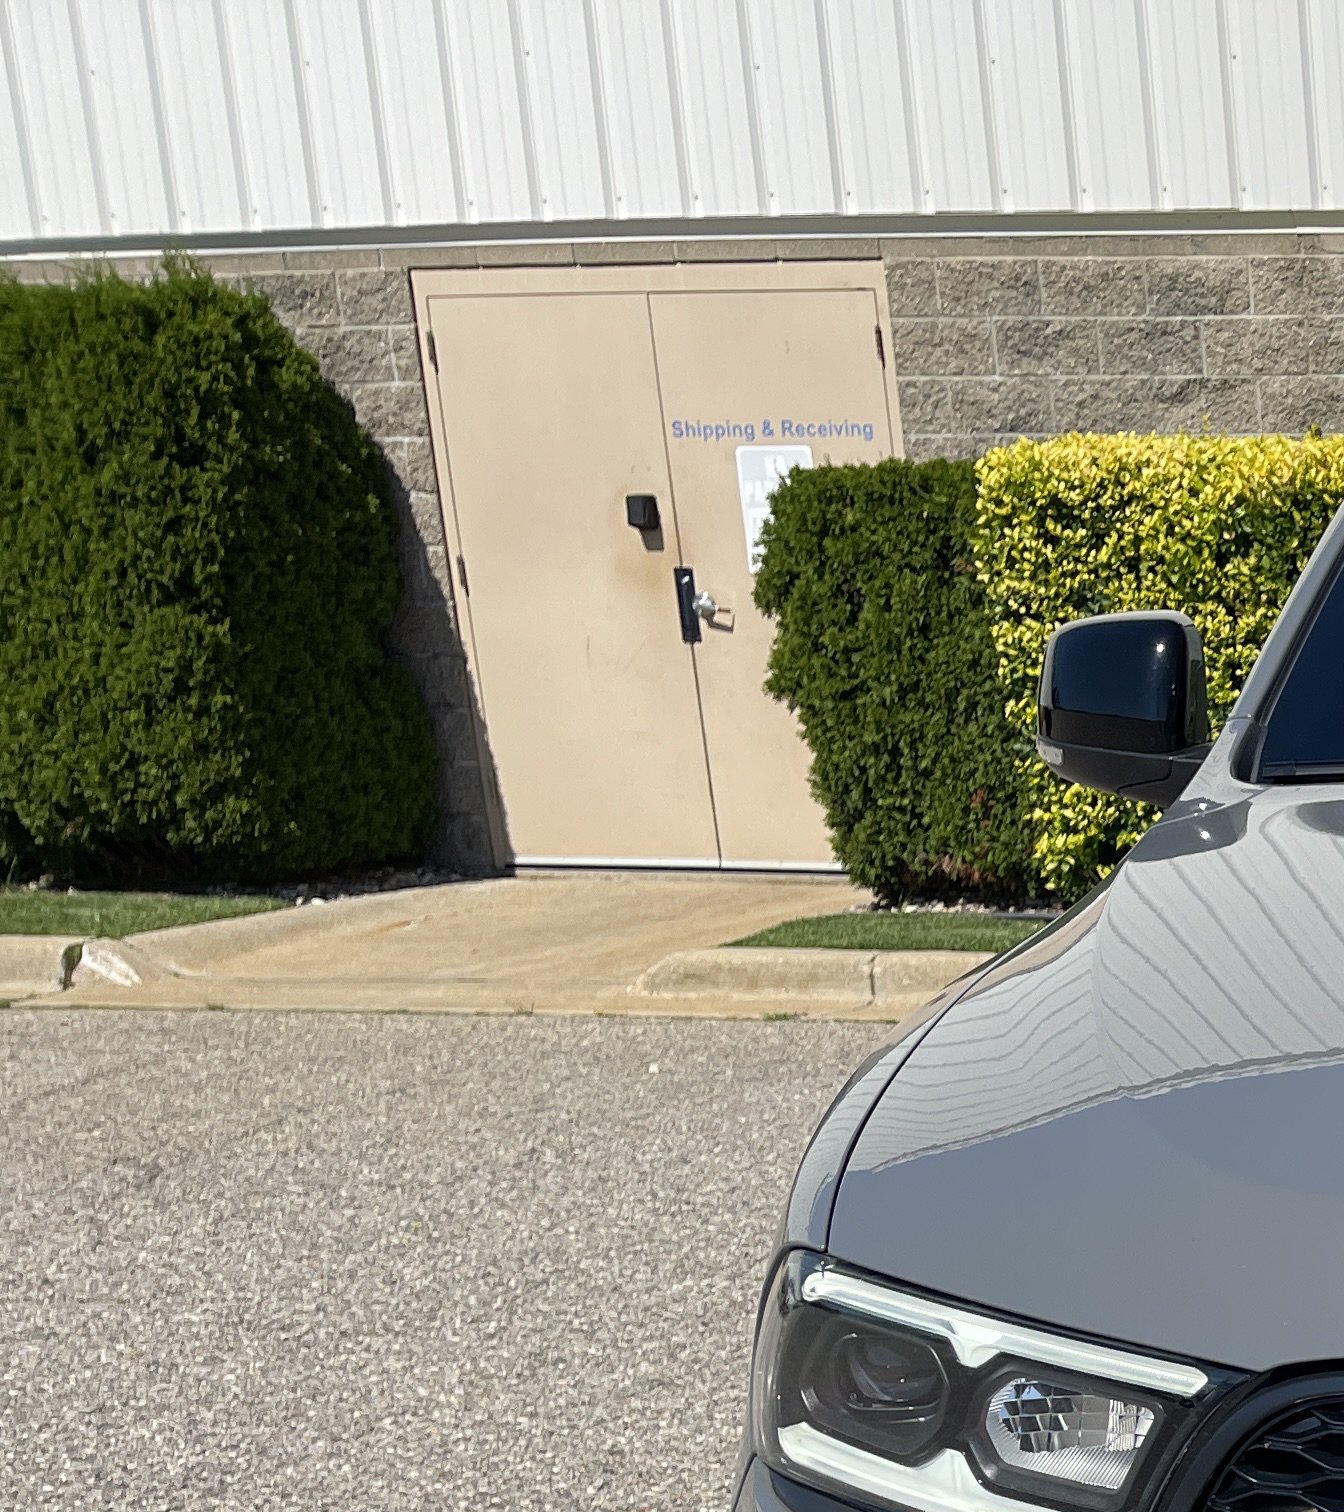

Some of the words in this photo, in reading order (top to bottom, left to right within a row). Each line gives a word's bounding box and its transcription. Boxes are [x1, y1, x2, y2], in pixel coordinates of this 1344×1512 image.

[671, 419, 756, 442] Shipping
[762, 419, 775, 438] &
[781, 419, 874, 442] Receiving
